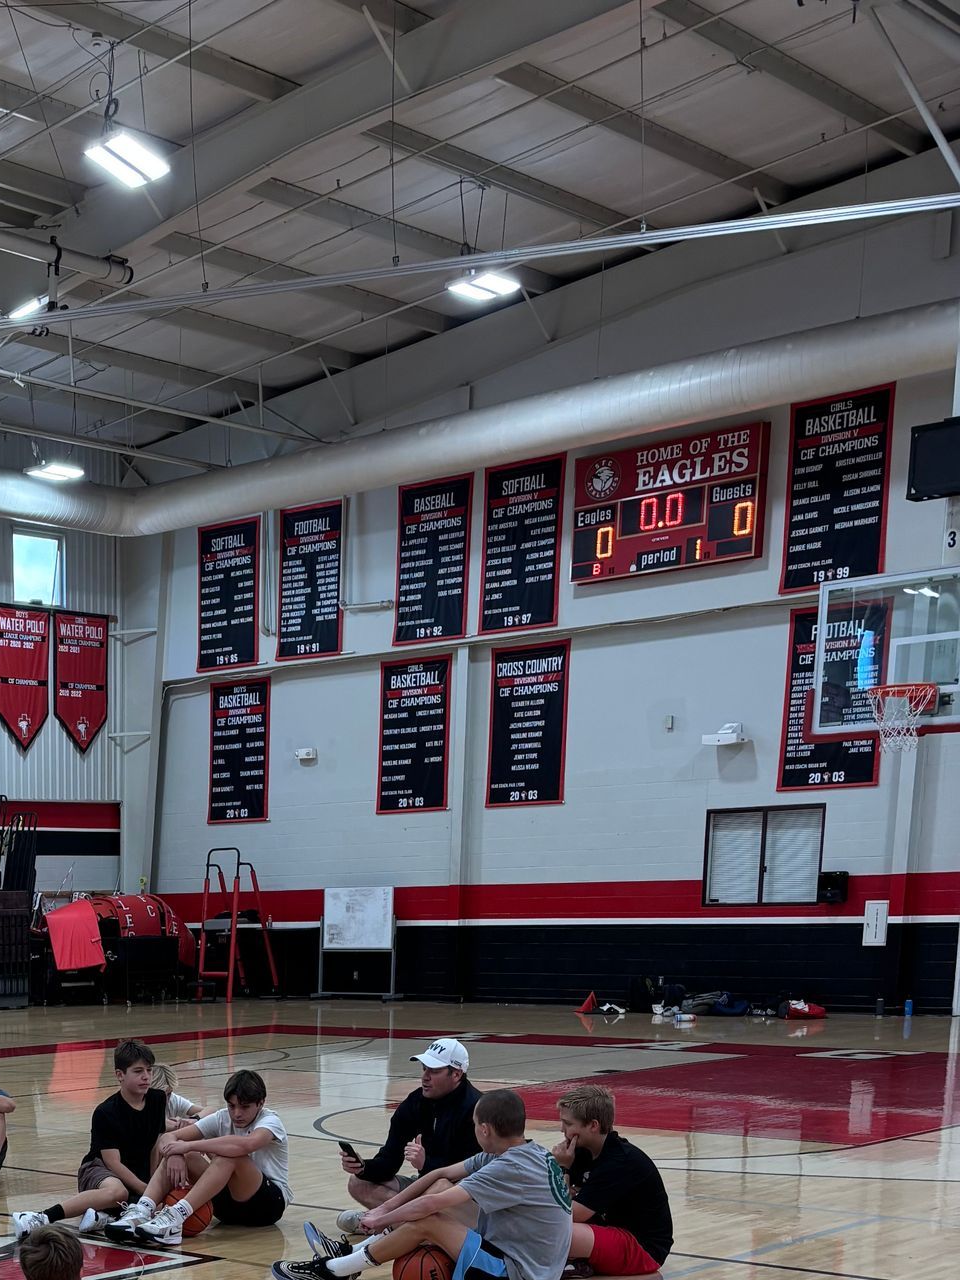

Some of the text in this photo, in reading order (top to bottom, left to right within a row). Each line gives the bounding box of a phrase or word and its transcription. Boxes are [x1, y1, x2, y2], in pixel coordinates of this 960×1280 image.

[831, 400, 852, 412] GIRLS
[806, 406, 876, 436] BASKETBALL
[822, 431, 851, 443] DIVISION
[636, 430, 750, 466] HOME OF THE
[801, 436, 879, 460] CIF CHAMPIONS
[635, 448, 748, 491] EAGLES
[502, 473, 546, 495] SOFTBALL
[509, 494, 533, 504] DIVISION
[712, 483, 752, 502] Guests
[414, 492, 455, 513] BASEBALL
[493, 499, 553, 518] CIF CHAMPIONS
[421, 512, 441, 521] DIVISION
[578, 509, 611, 527] Eagles
[640, 492, 684, 530] 0.0
[733, 501, 754, 535] 0
[295, 517, 330, 535] FOOTBALL
[406, 517, 461, 534] CIF CHAMPIONS
[211, 534, 245, 551] SOFTBALL
[300, 535, 319, 543] DIVISION
[596, 526, 613, 559] 0
[947, 531, 957, 548] 3
[217, 551, 235, 559] DIVISION
[287, 541, 336, 555] CIF CHAMPIONS
[696, 538, 701, 560] 1
[205, 556, 251, 571] CIF CHAMPIONS
[641, 548, 676, 568] period
[813, 567, 849, 582] 19 99
[0, 616, 44, 633] WATER POLO
[504, 614, 531, 626] 19 97
[60, 623, 103, 640] WATER POLO
[416, 626, 442, 638] 19 92
[811, 619, 865, 640] FOTBALL
[297, 643, 319, 654] 19 91
[799, 647, 875, 665] CIF HAMPIONS
[216, 653, 238, 665] 19 85
[497, 656, 563, 677] CROSS COUNTRY
[408, 664, 423, 672] GIRLS
[391, 671, 439, 689] BASKETBALL
[514, 676, 537, 684] DIVISION
[402, 689, 423, 697] DIVISION
[500, 683, 558, 697] CIF CHAMPIONS
[220, 693, 260, 708] BASKETBALL
[388, 695, 441, 708] CIF CHAMPIONS
[217, 714, 262, 726] CIF CHAMPIONS
[808, 771, 844, 783] 20 03
[399, 797, 424, 807] 20 03
[510, 790, 538, 800] 20 03
[226, 810, 234, 818] 20
